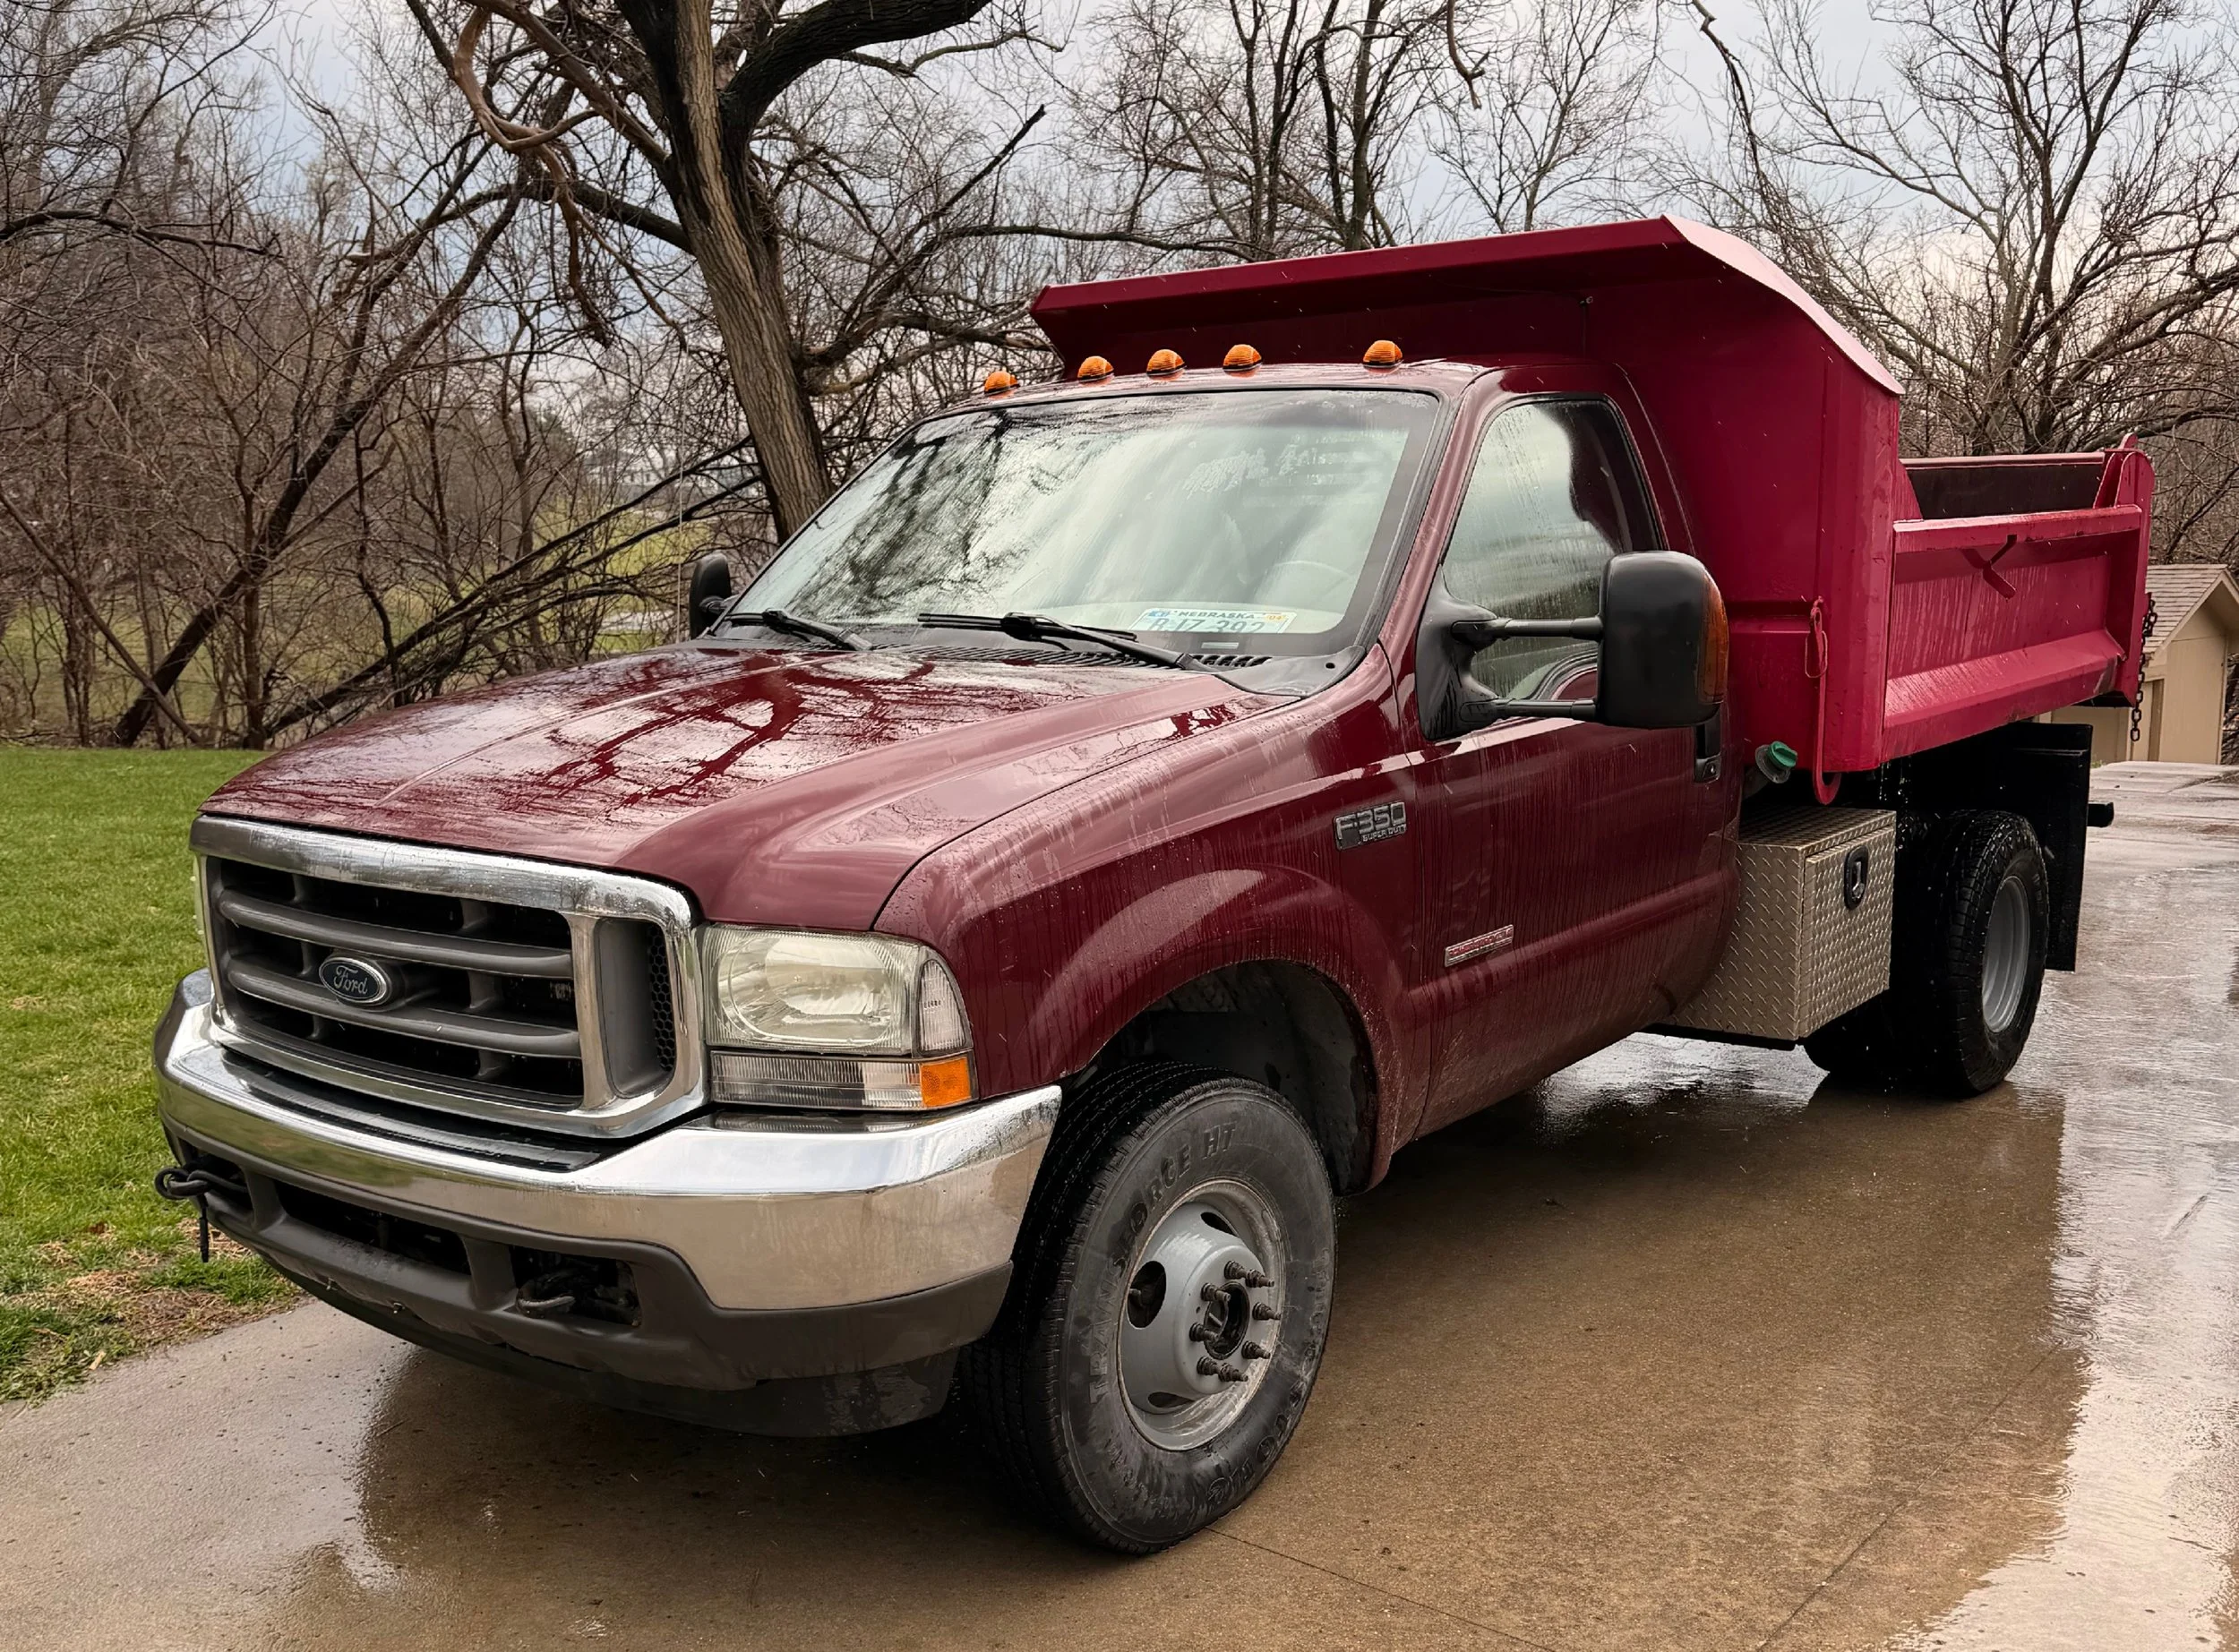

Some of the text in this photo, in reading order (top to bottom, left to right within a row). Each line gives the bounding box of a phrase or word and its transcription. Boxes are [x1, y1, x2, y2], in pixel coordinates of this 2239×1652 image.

[1178, 610, 1256, 620] NEBRASKA
[1361, 829, 1387, 842] SUPER
[333, 965, 368, 995] Ford
[1203, 1120, 1238, 1160] HT
